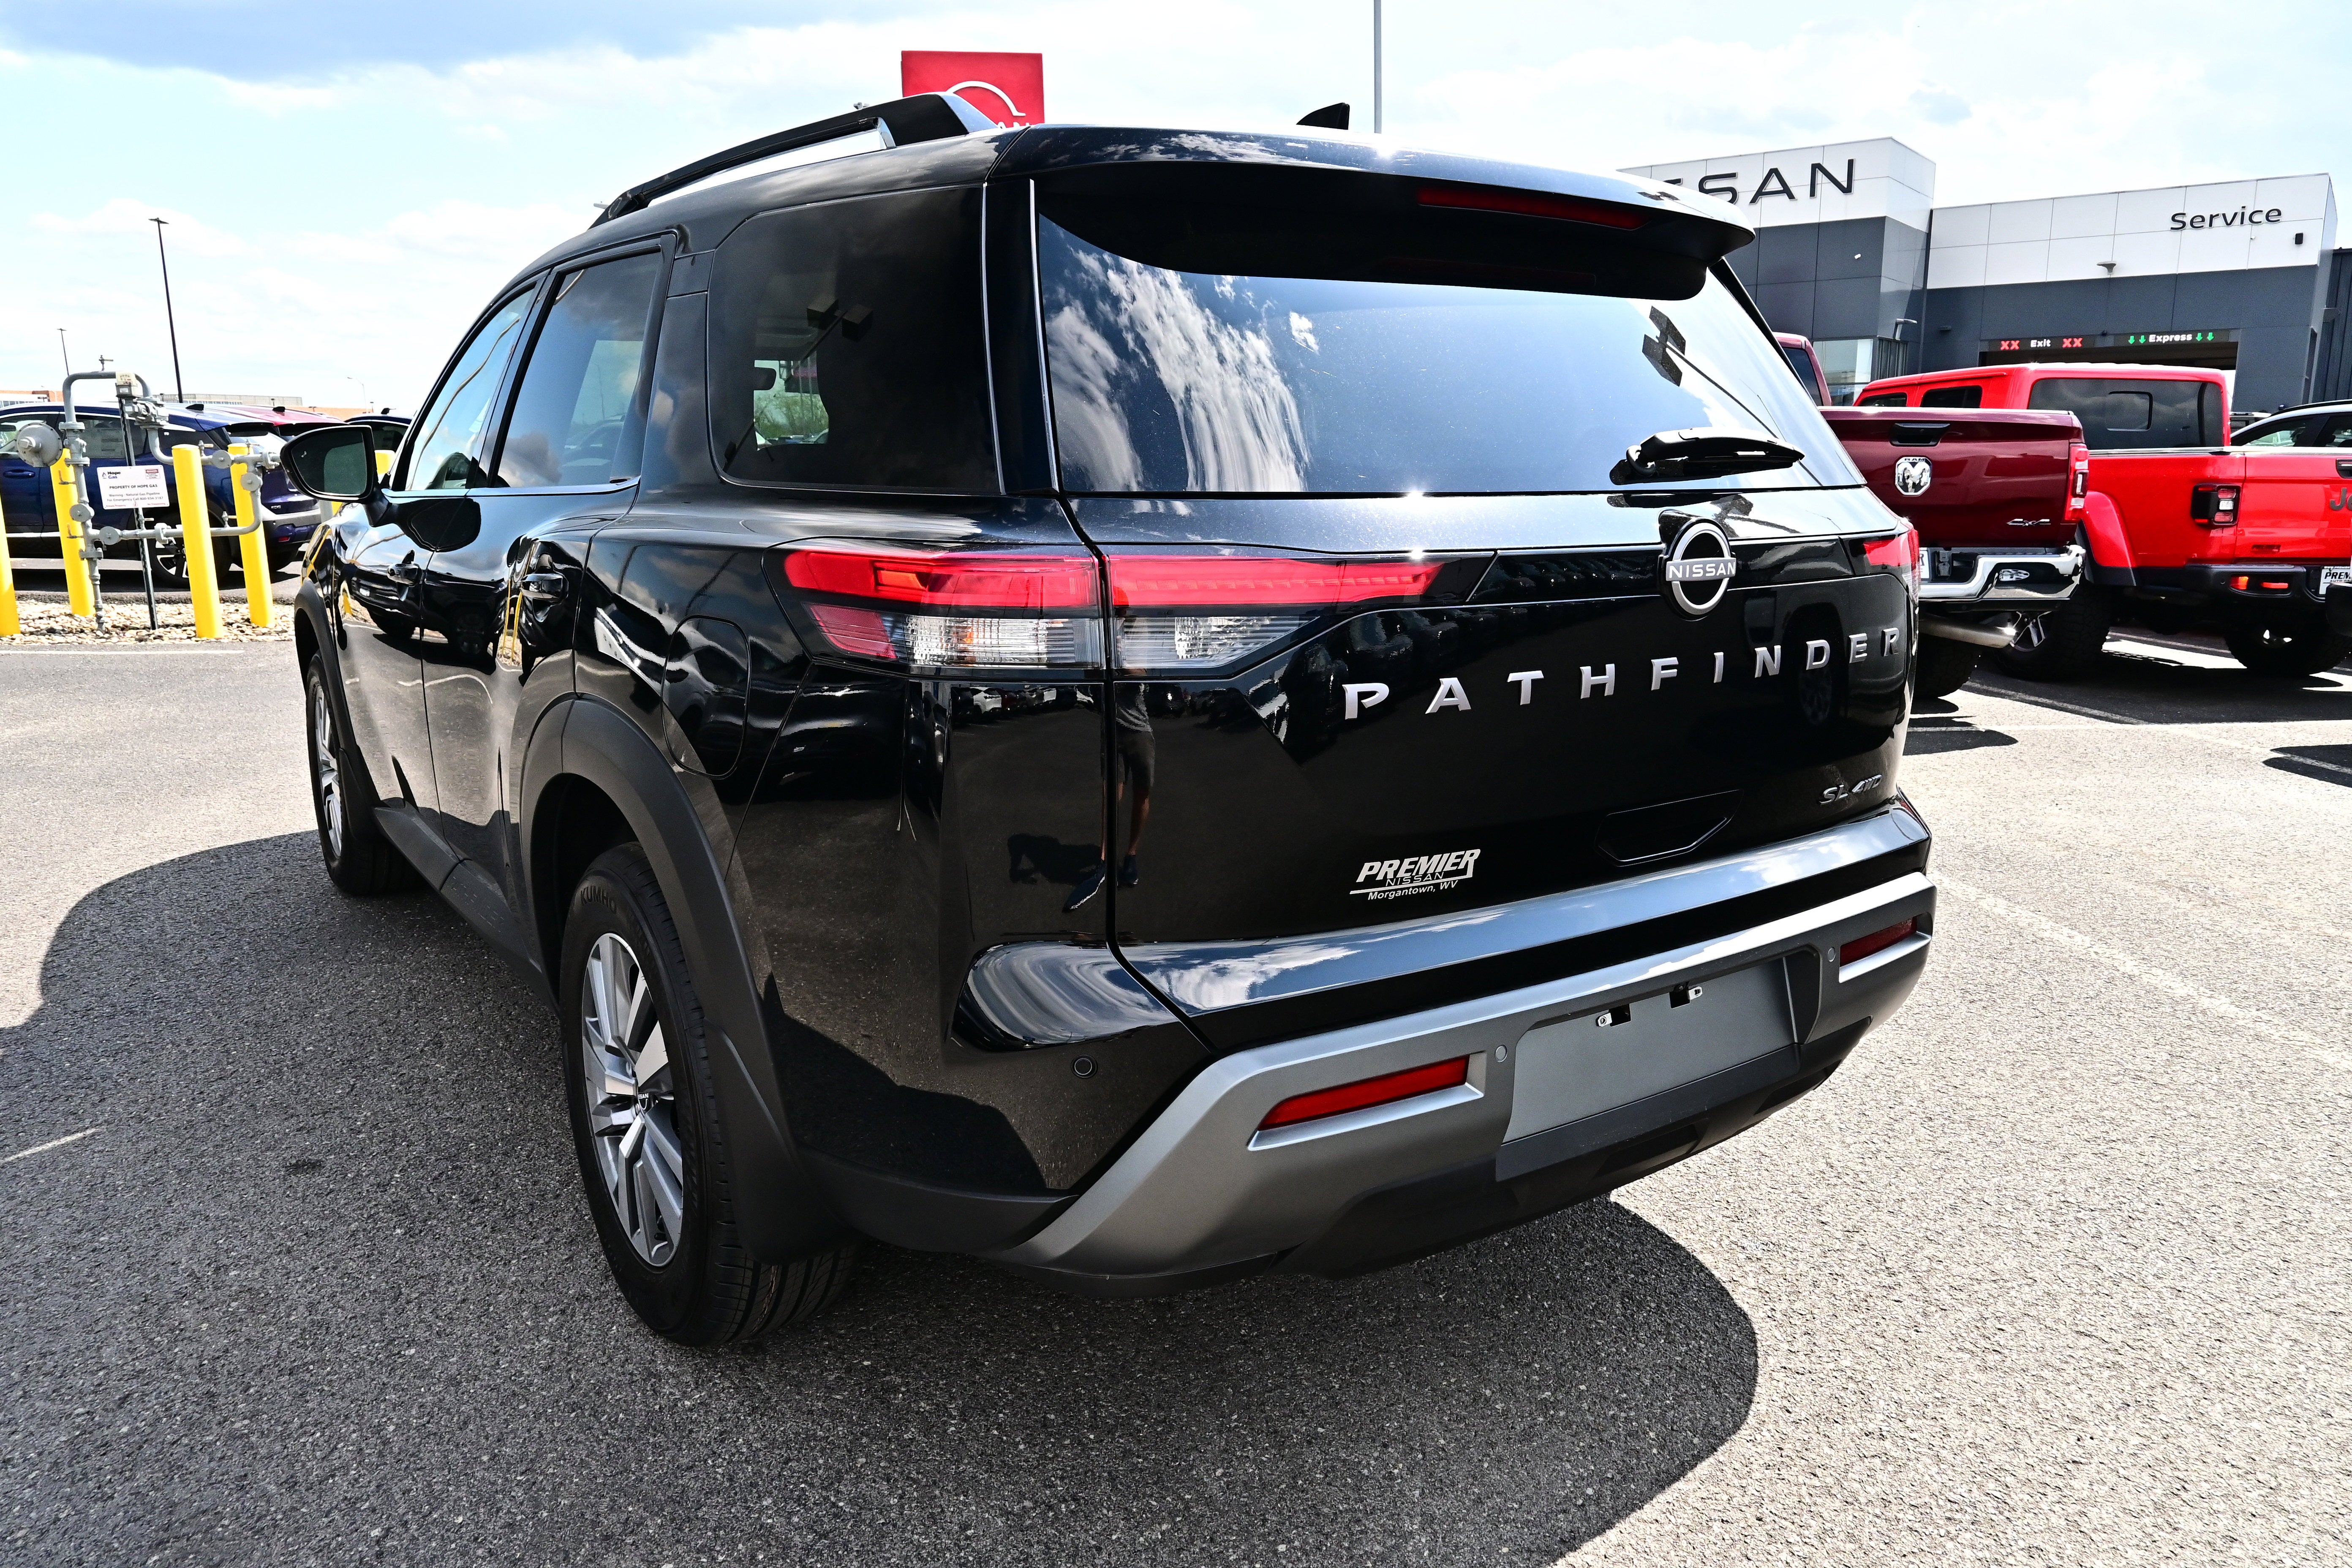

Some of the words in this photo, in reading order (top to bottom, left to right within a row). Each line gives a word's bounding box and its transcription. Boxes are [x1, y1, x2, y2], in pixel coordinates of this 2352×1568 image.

[1663, 158, 1855, 205] SAN
[2170, 206, 2282, 231] Service
[2030, 339, 2051, 348] Exit
[2148, 333, 2193, 343] Express
[1669, 561, 1736, 578] NISSAN
[1342, 627, 1901, 720] PATHFINDER
[1818, 784, 1849, 806] SL
[1852, 774, 1882, 794] 4WD
[1356, 849, 1481, 882] PREMIER
[1368, 885, 1436, 901] Morgantown,
[1440, 880, 1458, 890] WV
[1386, 872, 1444, 887] NISSAN
[580, 885, 617, 914] KUMHO
